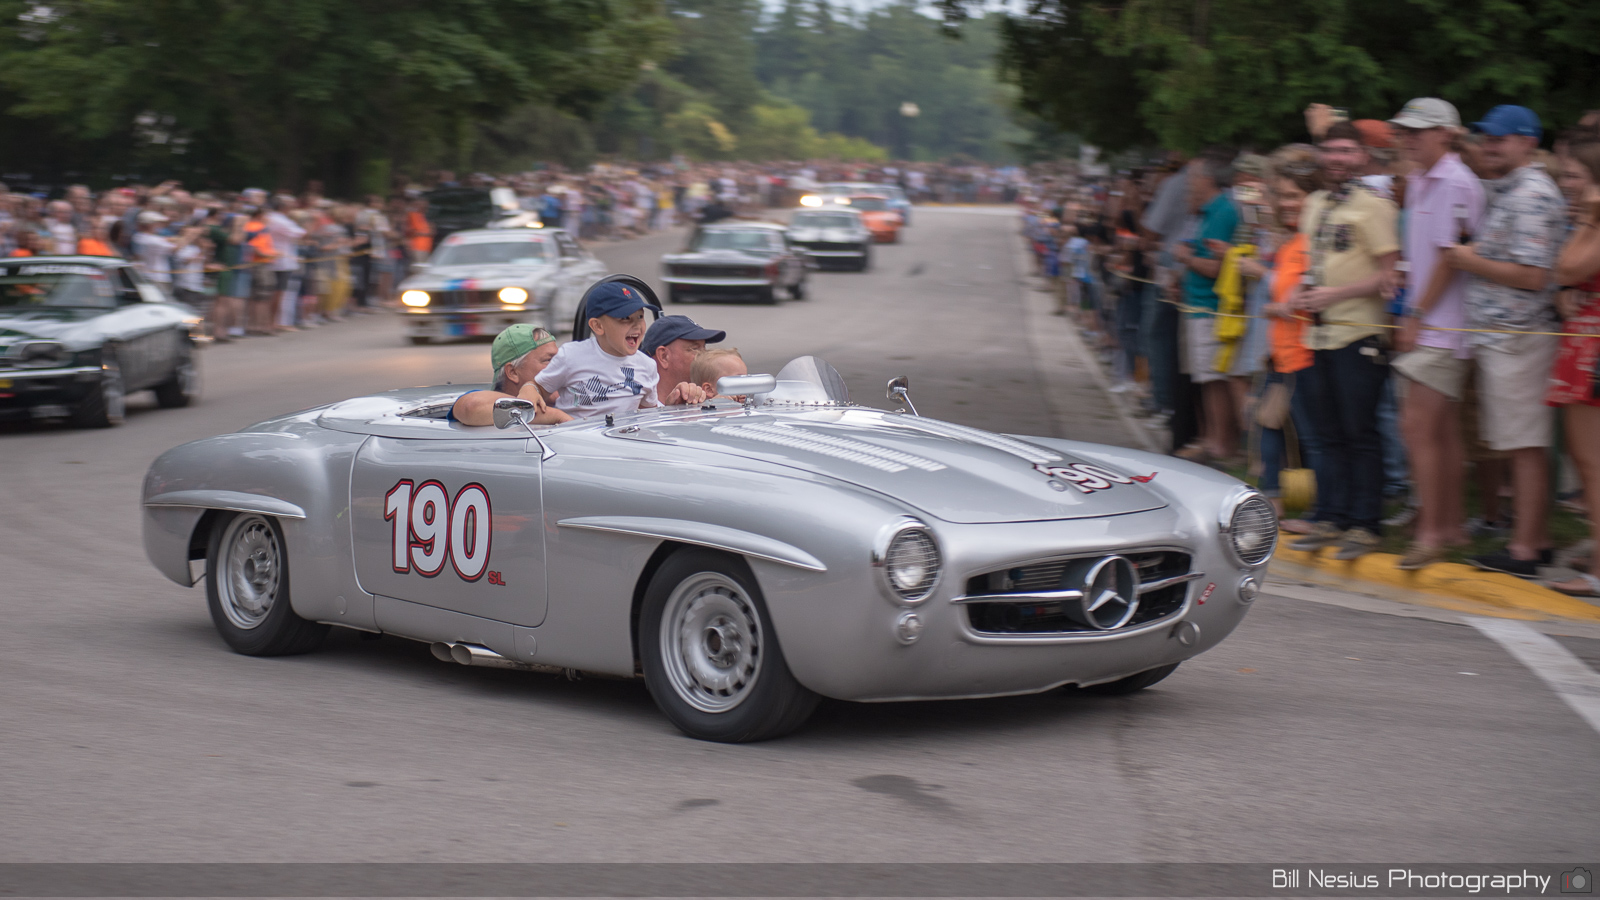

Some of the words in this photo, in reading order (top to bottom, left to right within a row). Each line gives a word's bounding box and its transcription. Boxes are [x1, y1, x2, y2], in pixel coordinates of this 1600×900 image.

[1032, 463, 1135, 494] 190
[384, 478, 493, 583] 190
[487, 570, 506, 587] SL
